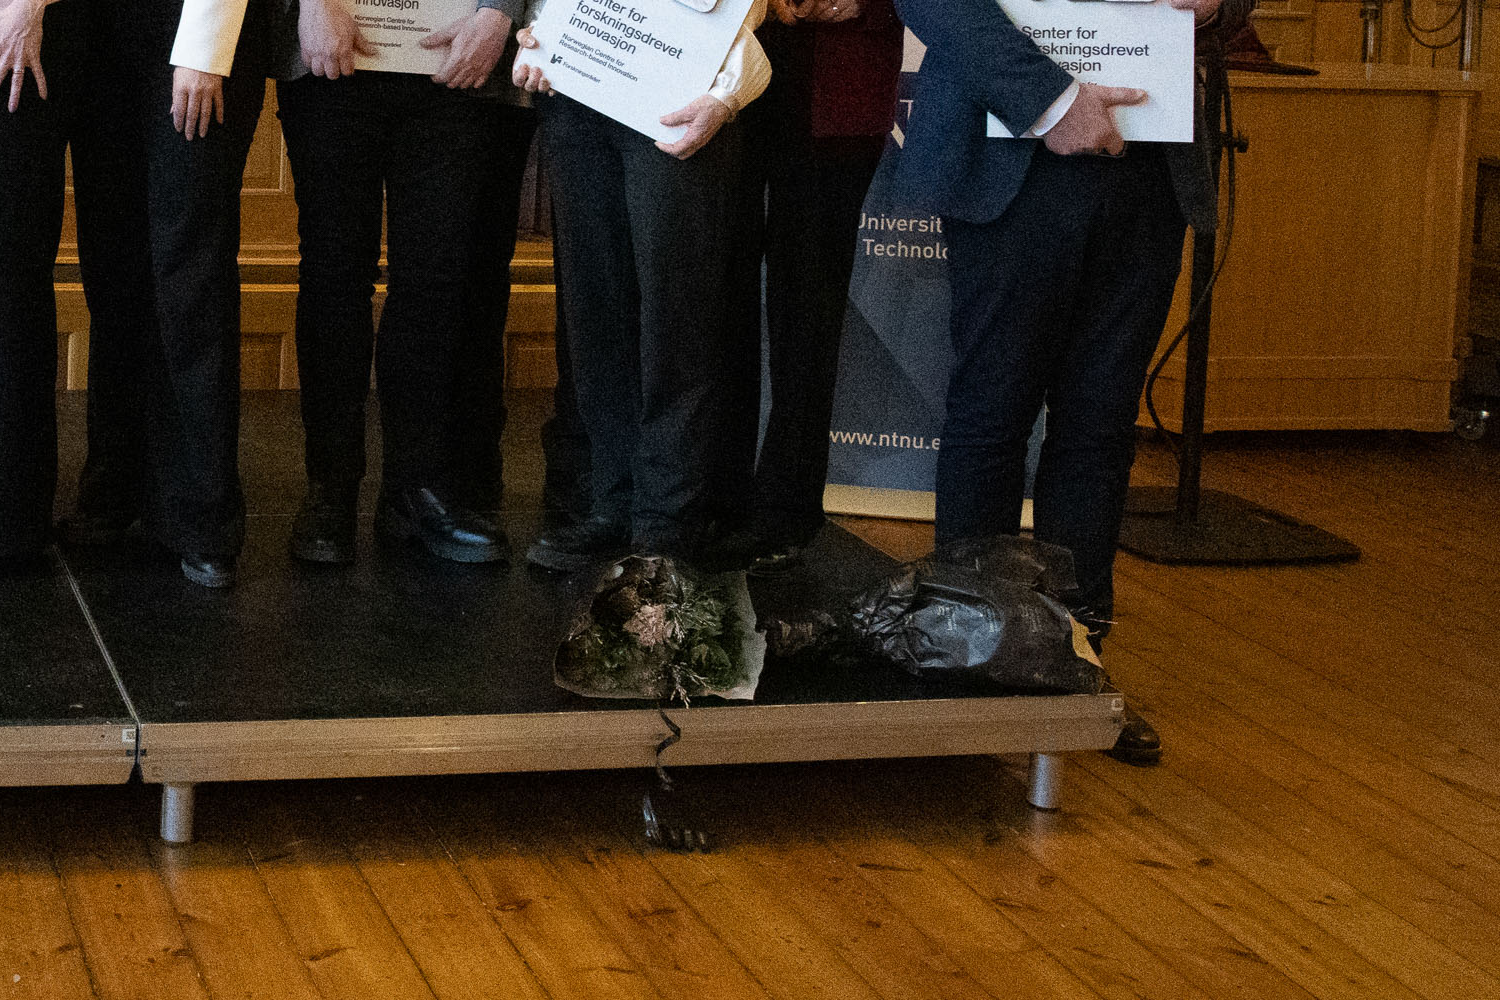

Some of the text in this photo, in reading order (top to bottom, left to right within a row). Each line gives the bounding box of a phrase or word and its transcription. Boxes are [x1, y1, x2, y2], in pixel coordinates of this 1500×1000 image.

[628, 7, 648, 24] for
[568, 13, 637, 55] innovasjon
[576, 0, 684, 60] forskningsdrevet
[1021, 26, 1098, 40] Senter for
[562, 33, 625, 67] Norwegian Centre for
[558, 40, 638, 82] Research-based Innovation
[858, 212, 942, 233] Universit
[862, 238, 948, 259] Technol
[829, 430, 940, 450] www.ntnu.e
